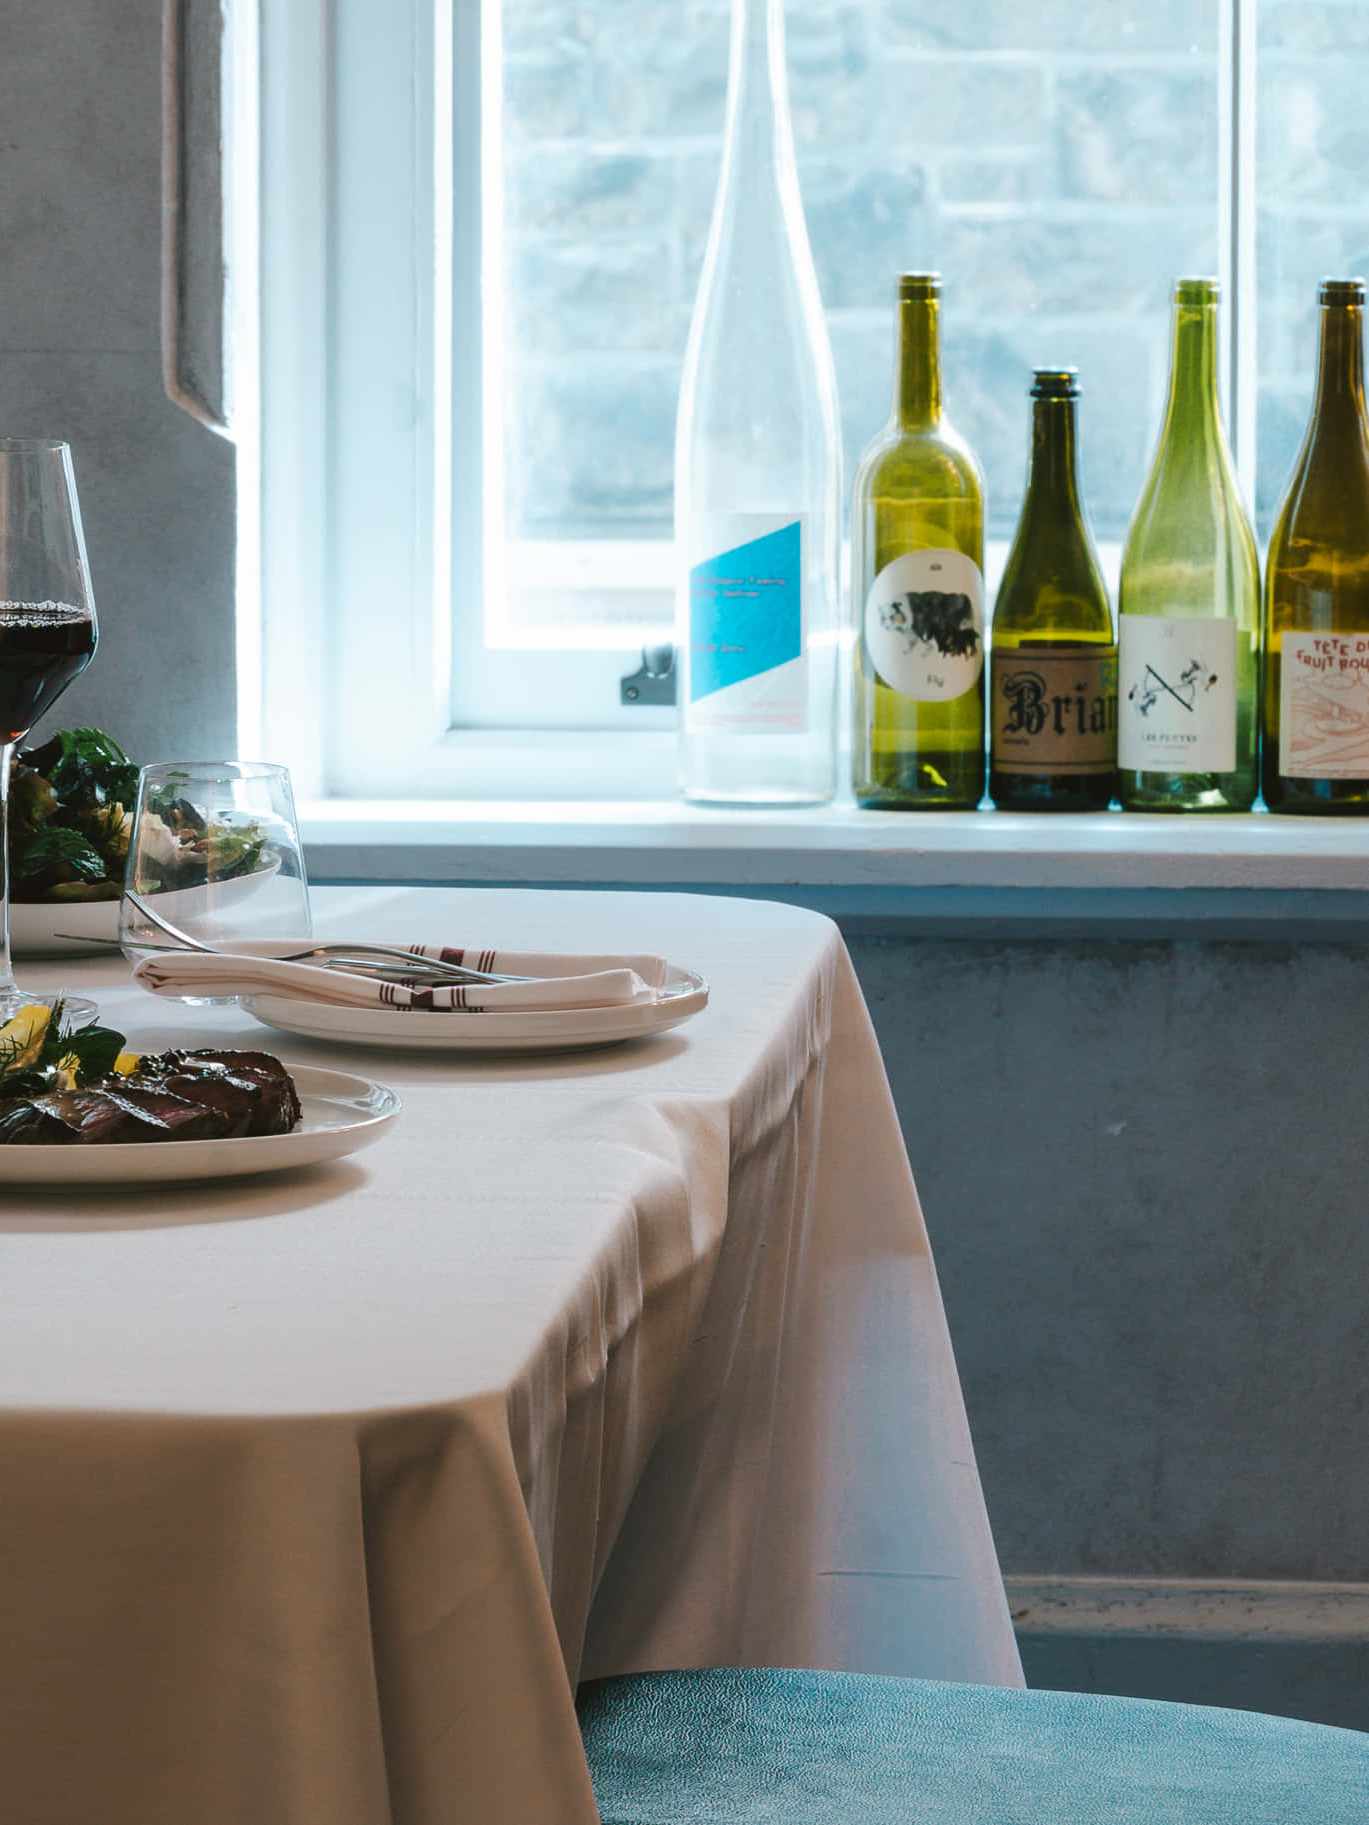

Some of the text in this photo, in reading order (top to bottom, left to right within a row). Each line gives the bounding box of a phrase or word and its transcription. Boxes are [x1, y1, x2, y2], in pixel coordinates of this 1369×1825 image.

[1355, 640, 1369, 653] D
[1296, 649, 1369, 673] FRUIT ROU
